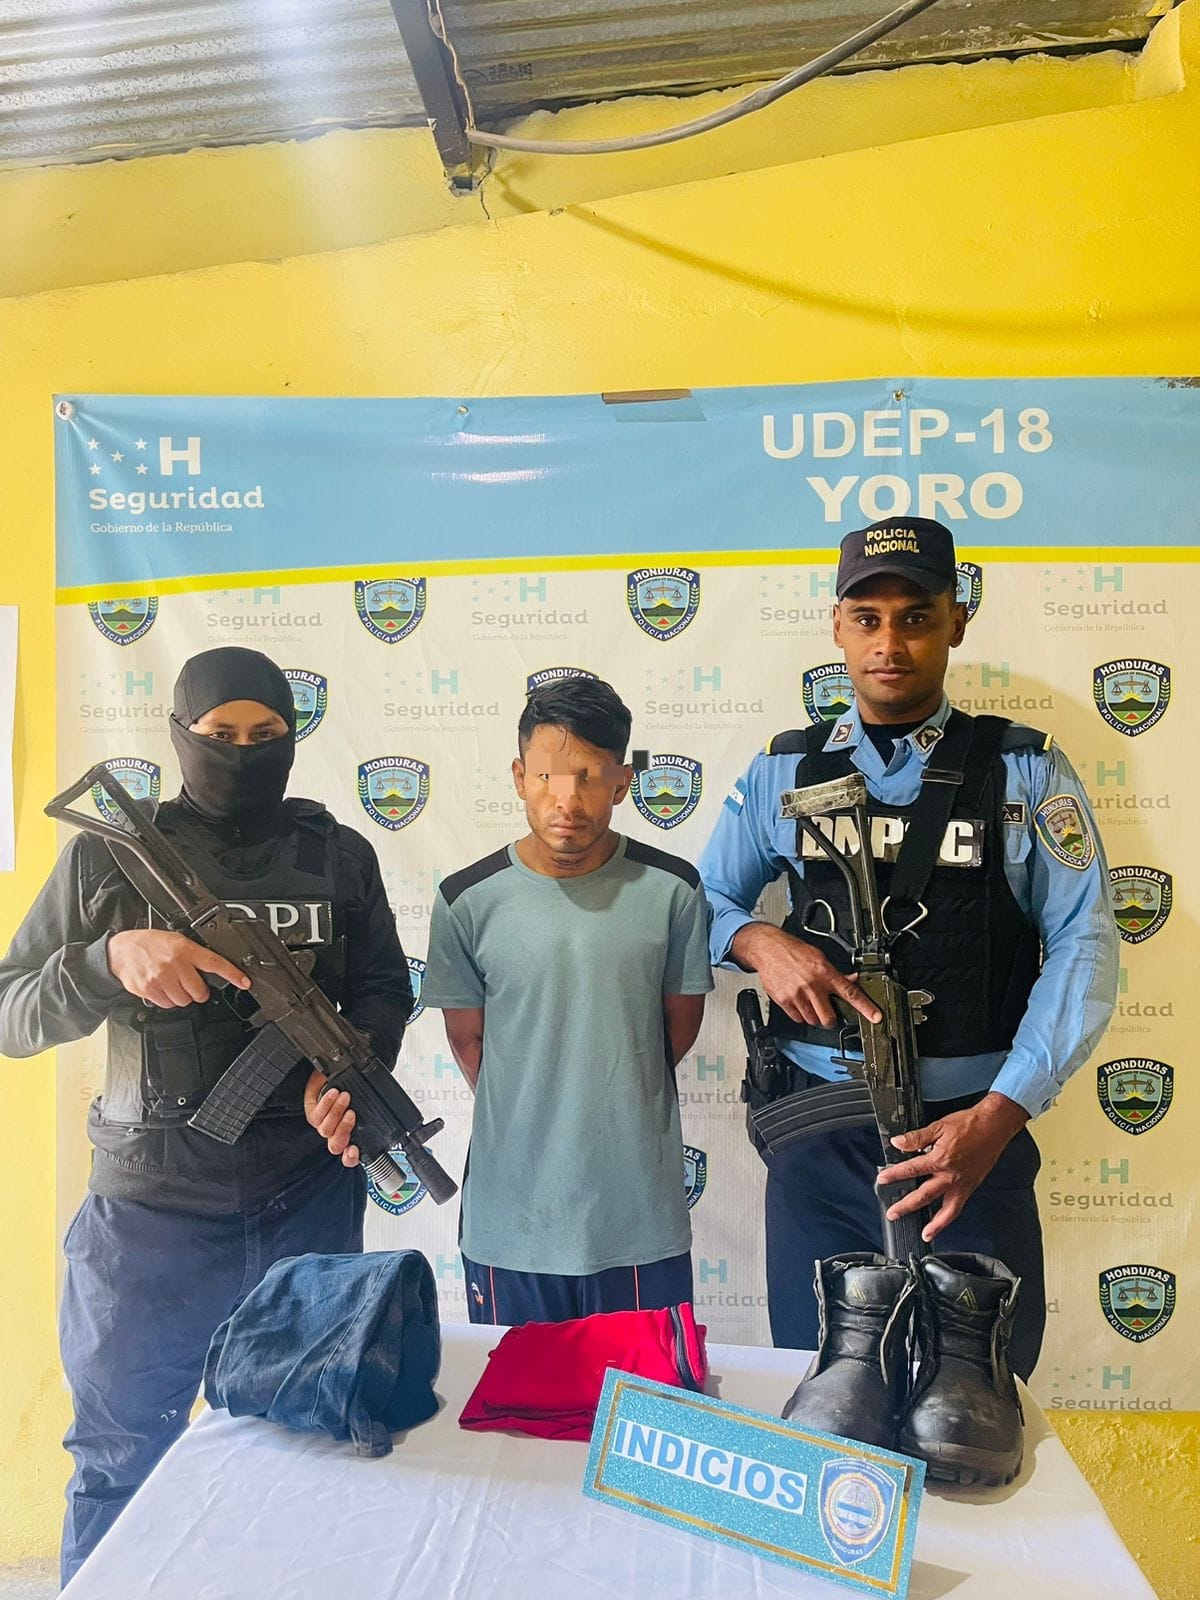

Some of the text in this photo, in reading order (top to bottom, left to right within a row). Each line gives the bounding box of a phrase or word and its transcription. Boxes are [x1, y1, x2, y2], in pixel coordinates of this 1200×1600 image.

[762, 407, 1053, 459] UDEP-18
[159, 436, 201, 476] H
[89, 485, 265, 515] Seguridad
[806, 472, 1023, 522] YORO
[90, 521, 233, 534] Gobierno de la República
[866, 528, 917, 542] POLICIA
[864, 540, 920, 557] NACIONAL
[633, 567, 695, 581] HONDURAS
[810, 572, 837, 597] H
[1094, 566, 1123, 592] H
[519, 576, 547, 602] H
[207, 611, 323, 630] Seguridad
[472, 609, 589, 628] Seguridad
[760, 605, 832, 624] Seguri
[1043, 599, 1168, 619] Seguridad
[123, 619, 153, 644] NACIONAL
[391, 616, 420, 642] NACIONAL
[664, 612, 695, 640] NACIONAL
[285, 671, 321, 685] DURAS
[693, 666, 721, 691] H
[809, 665, 848, 680] HONDU
[981, 661, 1010, 687] H
[1100, 661, 1165, 676] HONDURAS
[125, 671, 153, 696] H
[431, 669, 458, 694] H
[384, 701, 501, 720] Seguridad
[645, 699, 765, 717] Seguridad
[949, 695, 1054, 713] eguridad
[1132, 707, 1164, 735] NACIONAL
[105, 759, 155, 774] ONDURAS
[364, 758, 425, 774] HONDURAS
[651, 756, 697, 771] NDURAS
[1097, 760, 1126, 787] H
[394, 804, 424, 830] NACIONAL
[666, 801, 697, 828] NACIONAL
[1110, 867, 1166, 883] ONDURAS
[1134, 915, 1166, 943] NACIONAL
[697, 1055, 725, 1081] H
[1104, 1059, 1168, 1075] HONDURAS
[1135, 1106, 1168, 1134] NACIONAL
[1100, 1158, 1129, 1184] H
[1050, 1191, 1174, 1209] Seguridad
[699, 1258, 727, 1283] H
[1105, 1266, 1170, 1283] HONDURAS
[1138, 1314, 1170, 1341] NACIONAL
[1103, 1365, 1131, 1390] H
[1051, 1397, 1173, 1411] Seguridad
[614, 1420, 805, 1510] INDICIOS
[832, 1539, 863, 1555] HONDURAS
